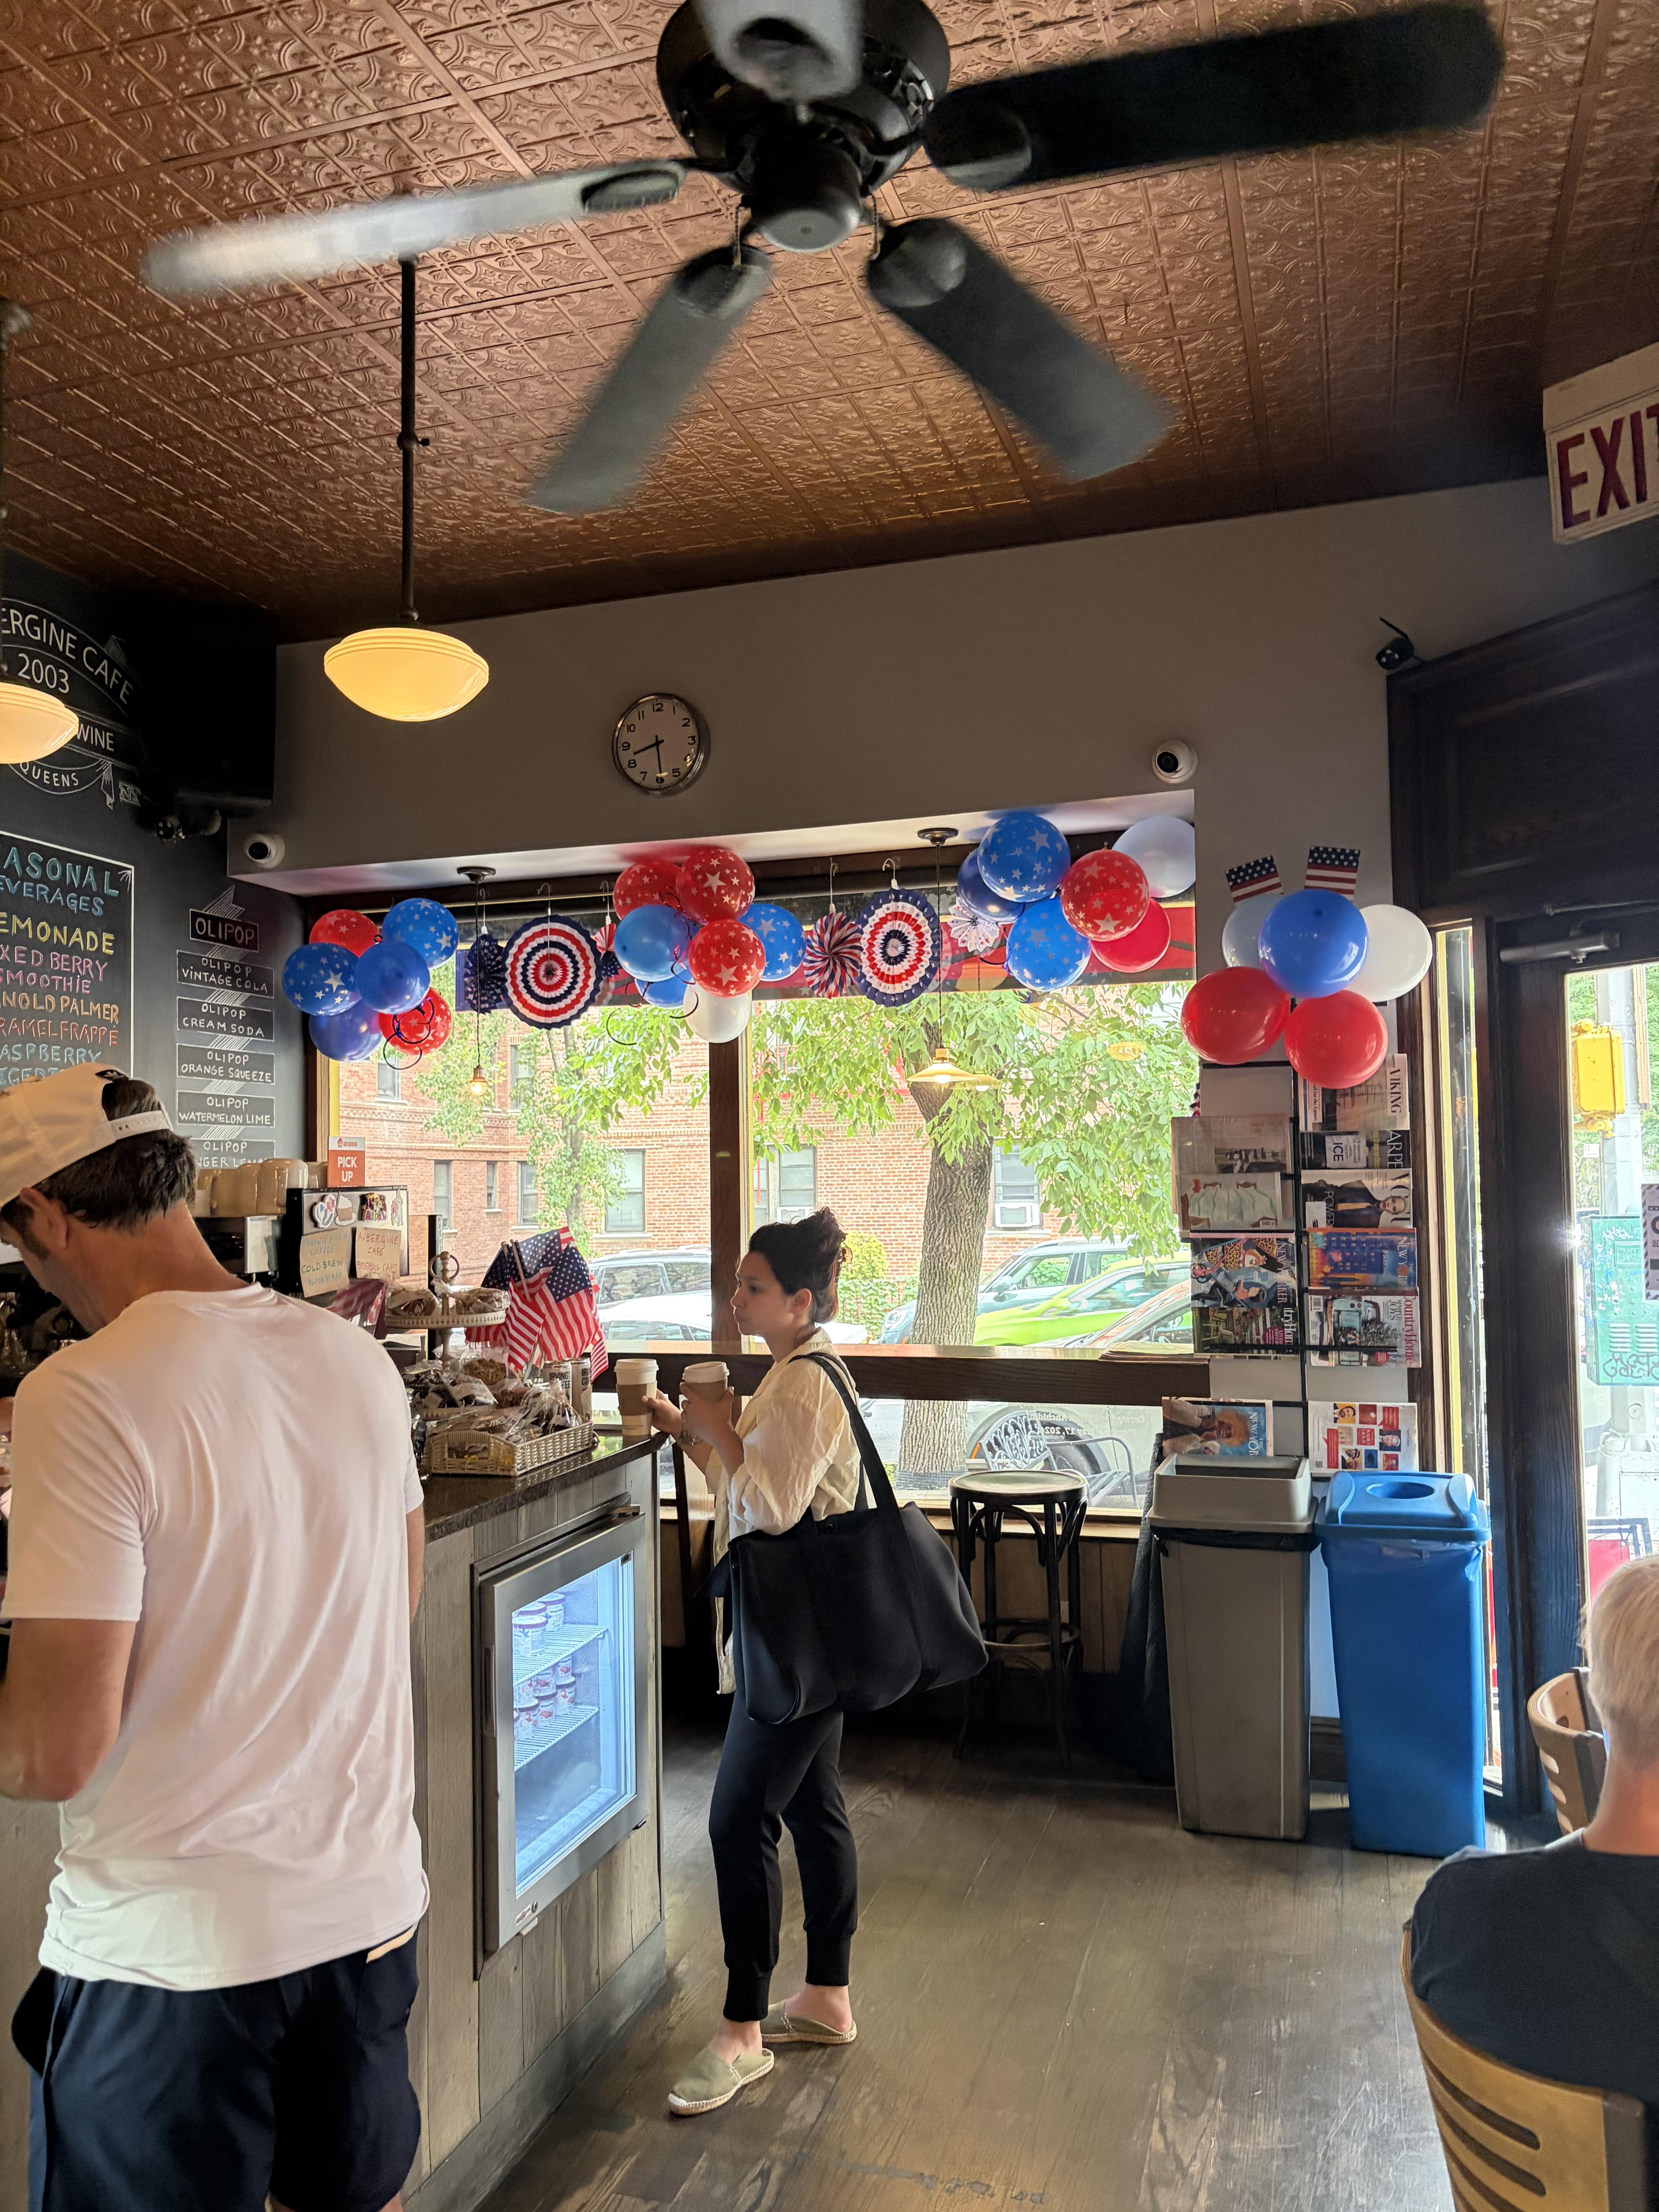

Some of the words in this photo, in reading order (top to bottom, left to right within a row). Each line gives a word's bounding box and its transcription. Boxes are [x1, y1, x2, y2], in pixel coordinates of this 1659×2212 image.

[18, 653, 70, 694] 2003
[83, 646, 133, 704] CAFE
[638, 710, 645, 720] 11
[652, 702, 664, 712] 12
[673, 706, 675, 715] 1
[626, 724, 636, 733] 10
[682, 718, 690, 727] 2
[77, 723, 114, 752] WINE
[687, 735, 696, 745] 3
[621, 741, 630, 751] 9
[627, 759, 637, 769] 8
[19, 762, 79, 788] QUEENS
[640, 771, 647, 781] 7
[672, 768, 681, 777] 5
[3, 847, 119, 897] ASONAL
[196, 917, 254, 945] OLIPOP
[0, 944, 43, 967] XED
[51, 952, 108, 982] BERRY
[202, 958, 251, 977] OLIPOP
[236, 979, 267, 994] COLA
[0, 991, 56, 1013] NOLD
[60, 995, 119, 1025] PALMER
[202, 1003, 246, 1020] OLIPOP
[183, 1017, 226, 1031] CREAM
[231, 1023, 264, 1037] SODA
[0, 1043, 102, 1066] ASPBERRY
[207, 1051, 249, 1065] OLIPOP
[181, 1064, 224, 1076] ORANGE
[229, 1068, 271, 1083] SQUEEZE
[1390, 1069, 1402, 1113] VIKING
[207, 1096, 248, 1111] OLIPOP
[179, 1112, 243, 1124] WATERMELON
[246, 1114, 270, 1125] LIME
[203, 1141, 247, 1154] OLIPOP
[1333, 1143, 1343, 1162] ICE
[1386, 1130, 1403, 1169] ARPE
[338, 1156, 358, 1168] PICK
[342, 1170, 353, 1182] UP
[358, 1232, 398, 1248] AUBERGINE
[1398, 1236, 1408, 1260] NEW
[368, 1247, 384, 1256] CAFE
[1276, 1243, 1286, 1264] NEW
[302, 1262, 321, 1273] COLD
[323, 1257, 343, 1269] BREW
[549, 1371, 568, 1381] IRVING
[1248, 1411, 1258, 1434] NEW
[1248, 1435, 1259, 1456] YOR
